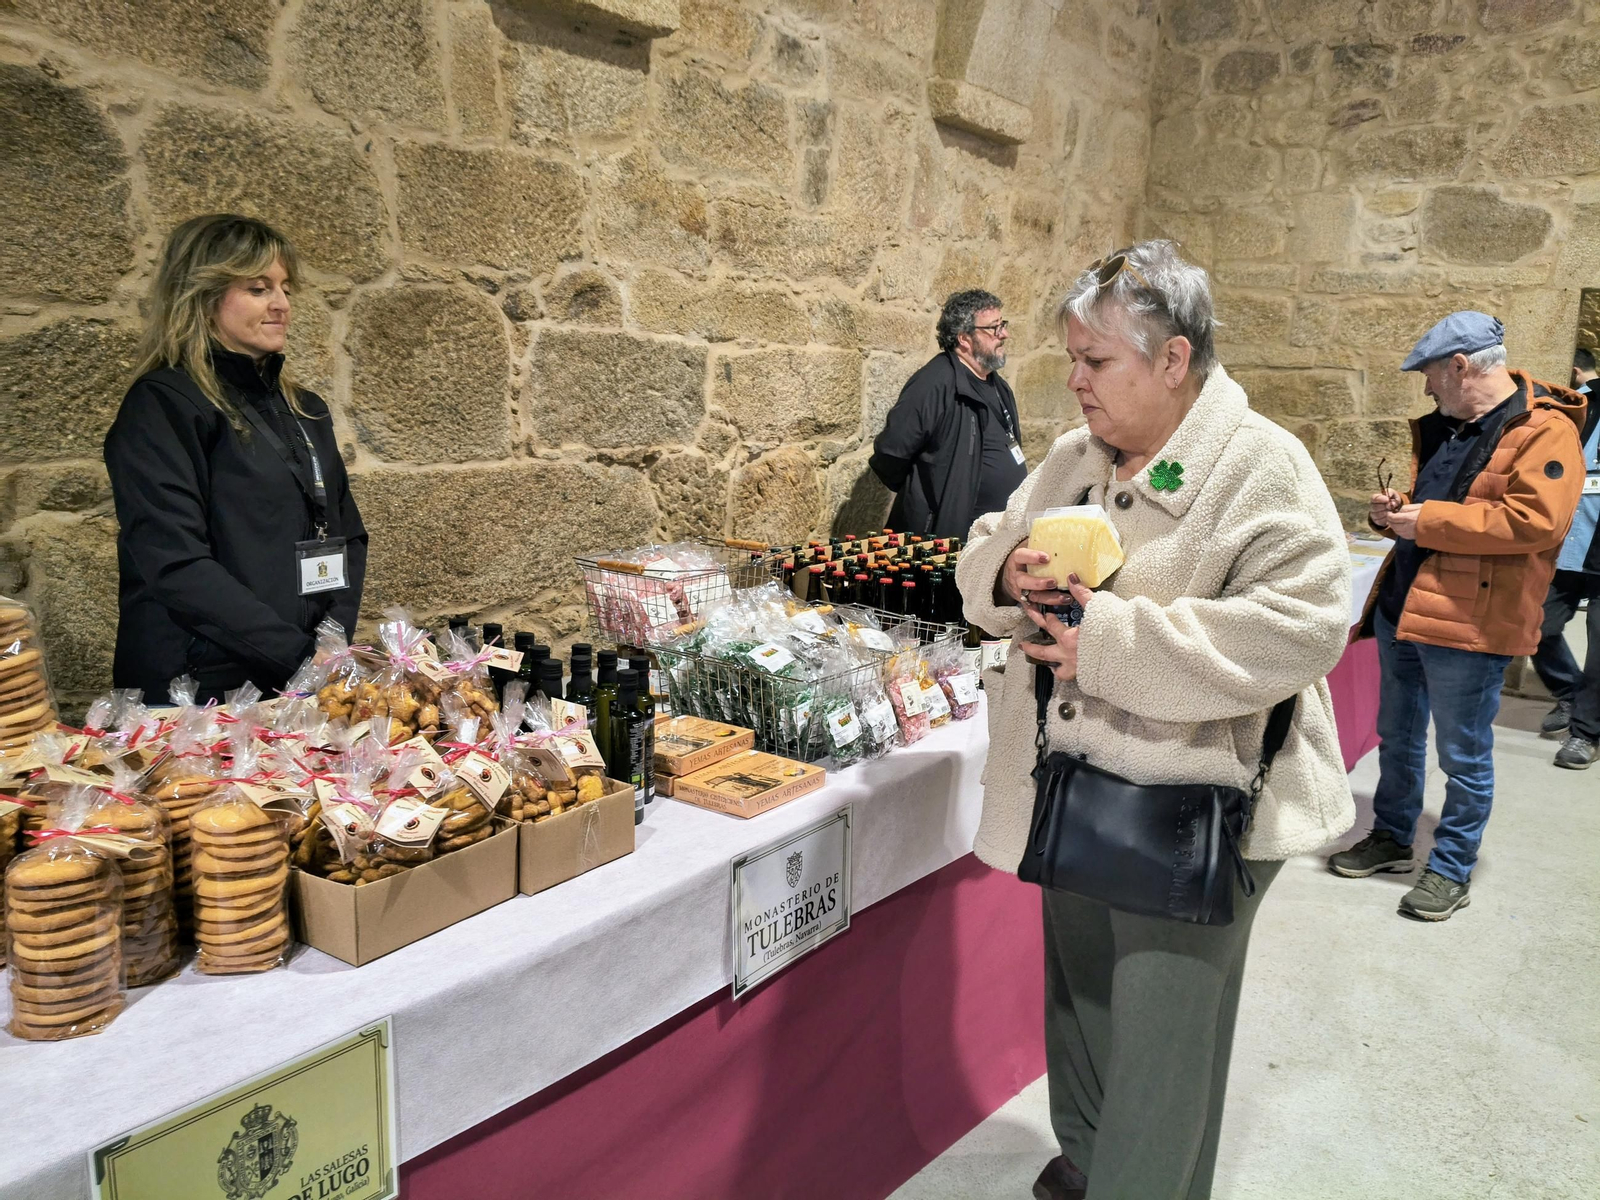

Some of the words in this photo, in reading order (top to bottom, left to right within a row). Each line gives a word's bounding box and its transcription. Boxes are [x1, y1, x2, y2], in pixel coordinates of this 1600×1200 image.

[689, 752, 711, 768] YEMAS
[713, 738, 749, 757] ARTESANAS
[756, 792, 779, 809] YEMAS
[782, 777, 820, 798] ARTESANAS
[744, 882, 821, 934] MONASTERIO
[825, 872, 840, 889] DE
[746, 888, 836, 958] TULEBRAS
[763, 939, 795, 963] (Tulebras,
[795, 920, 822, 943] Navarra)
[300, 1168, 321, 1188] LAS
[323, 1144, 369, 1176] SALESAS
[318, 1157, 369, 1200] LUGO
